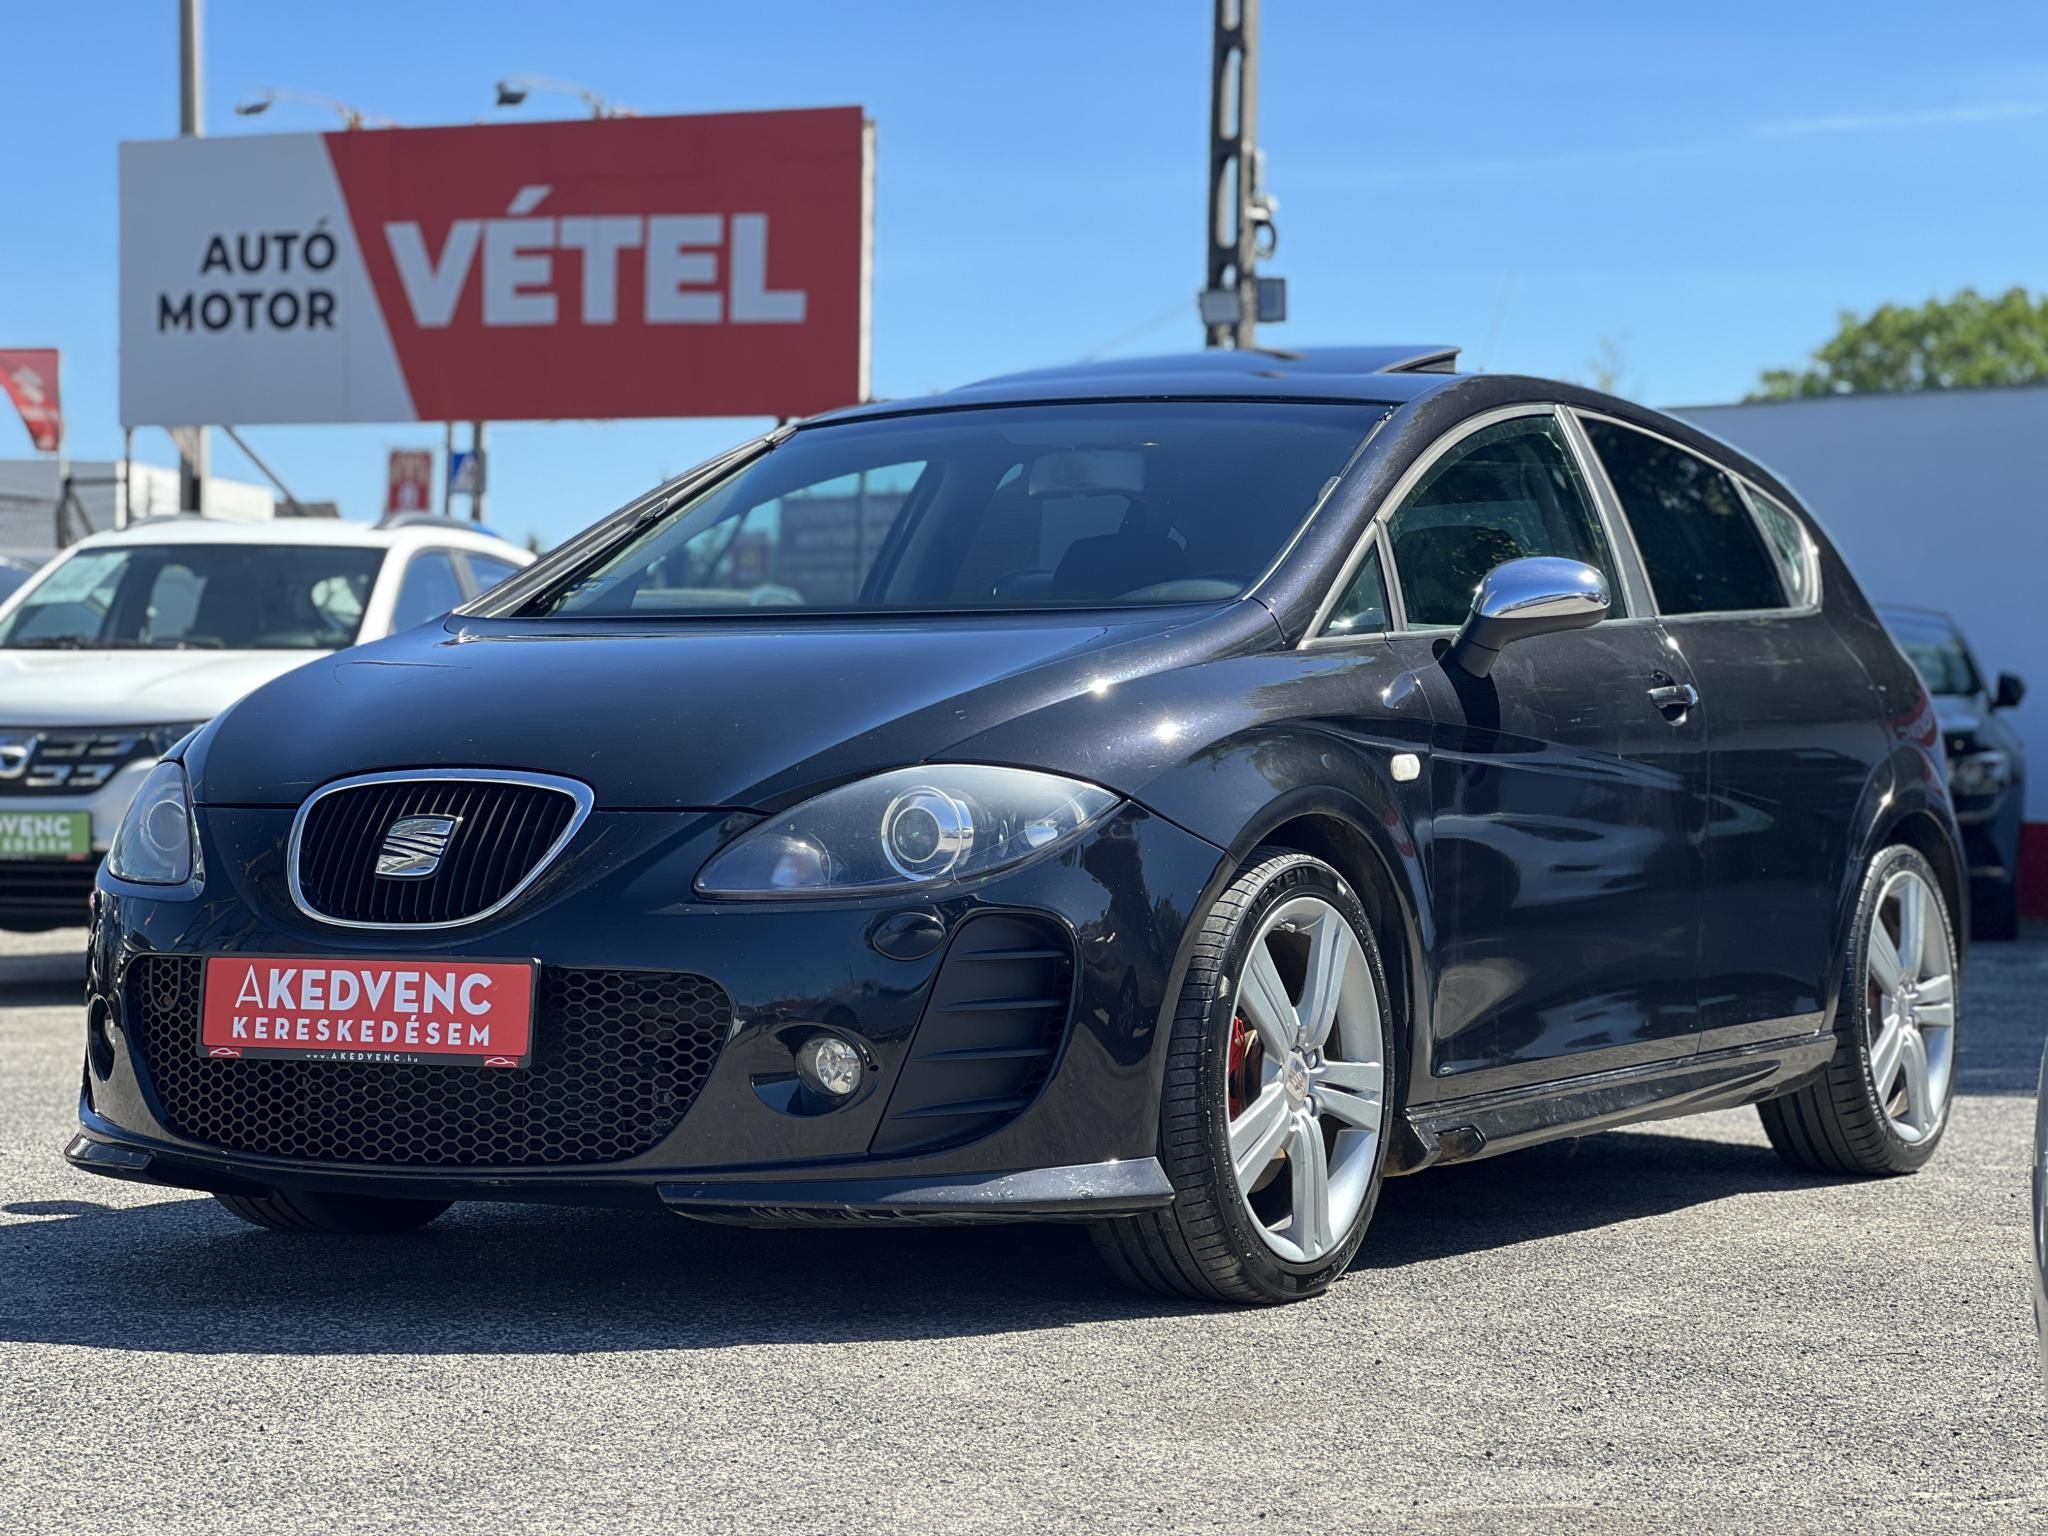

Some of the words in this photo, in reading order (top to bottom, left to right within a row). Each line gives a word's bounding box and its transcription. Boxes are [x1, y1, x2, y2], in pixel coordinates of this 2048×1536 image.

[200, 217, 337, 275] AUTÓ
[384, 185, 807, 328] VÉTEL
[158, 289, 337, 334] MOTOR
[0, 815, 71, 837] VENC
[232, 1015, 490, 1047] KERESKEDÉSEM
[306, 1052, 418, 1063] www.AKEDVENC.hu
